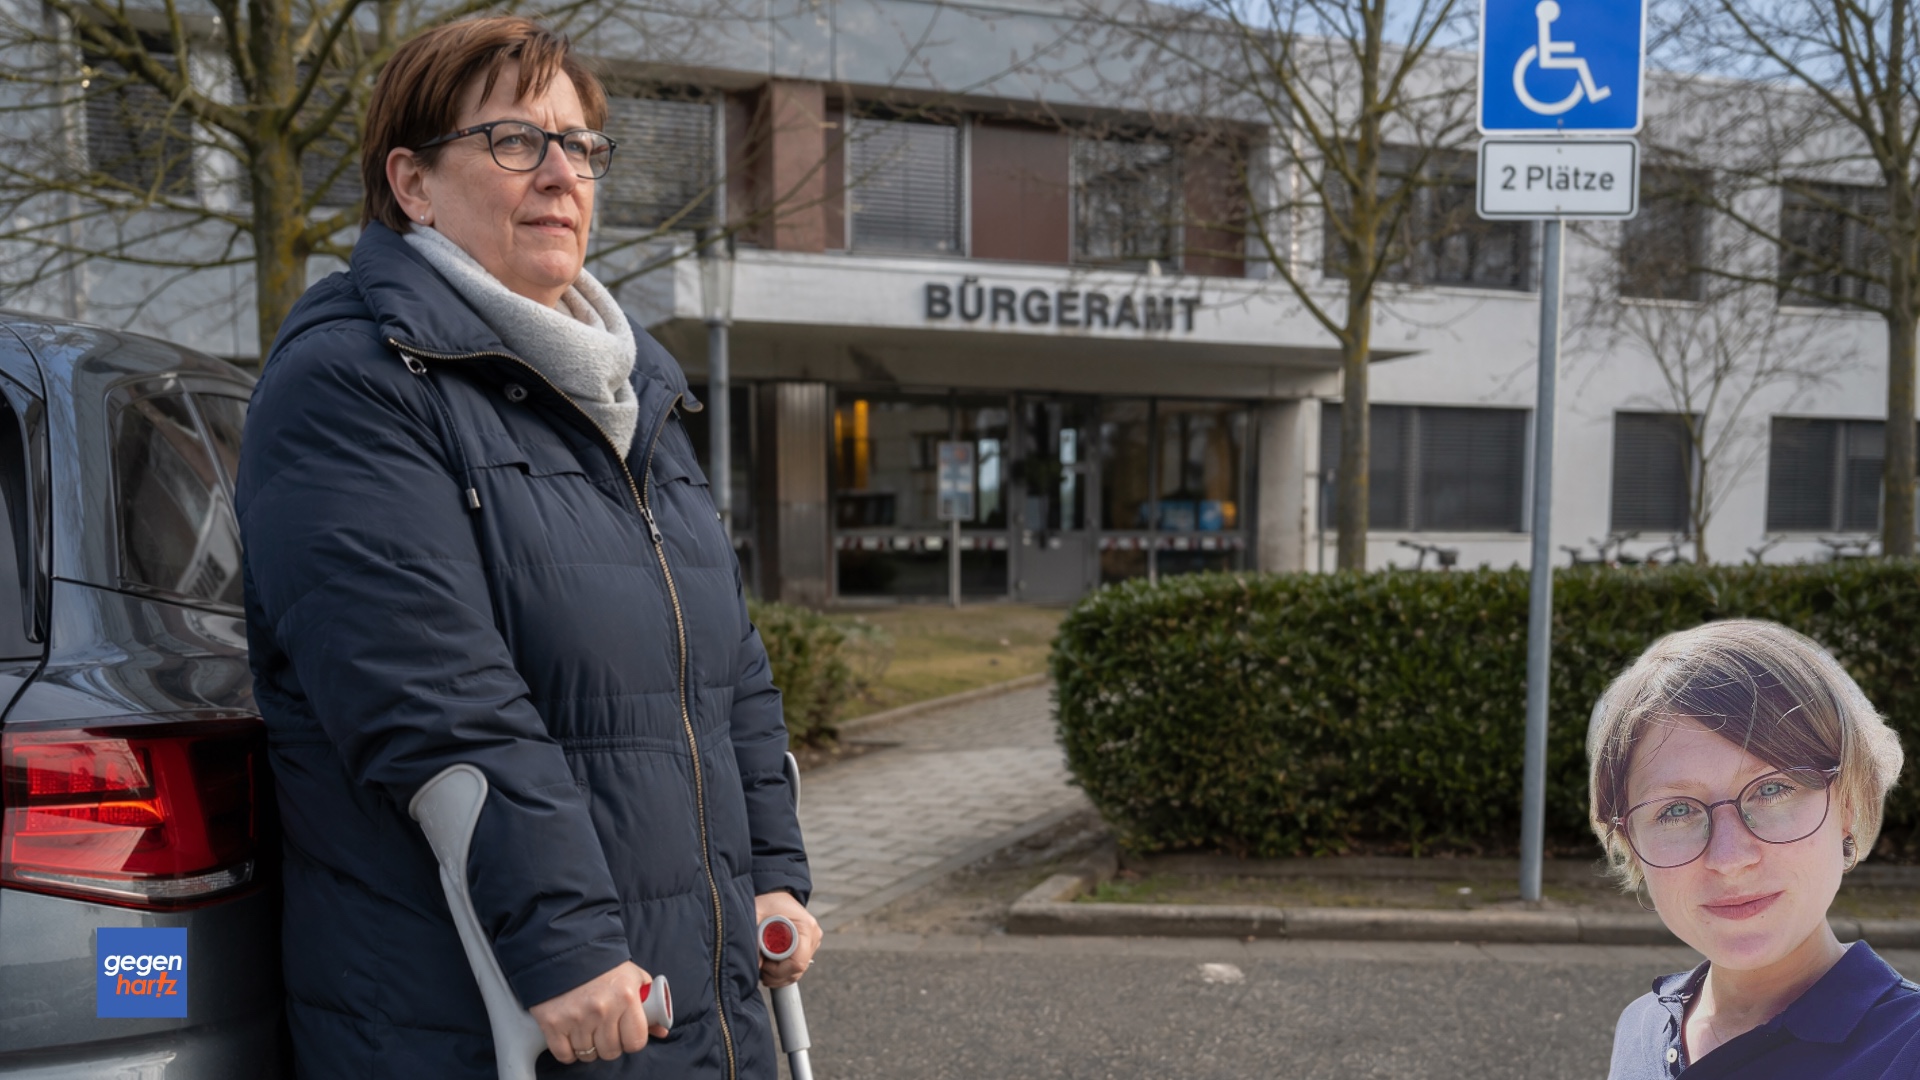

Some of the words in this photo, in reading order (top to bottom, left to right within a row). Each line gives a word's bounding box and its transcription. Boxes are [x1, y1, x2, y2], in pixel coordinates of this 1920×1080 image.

[1501, 165, 1516, 191] 2
[1526, 165, 1615, 191] Plätze
[924, 275, 1198, 332] BÜRGERAMT
